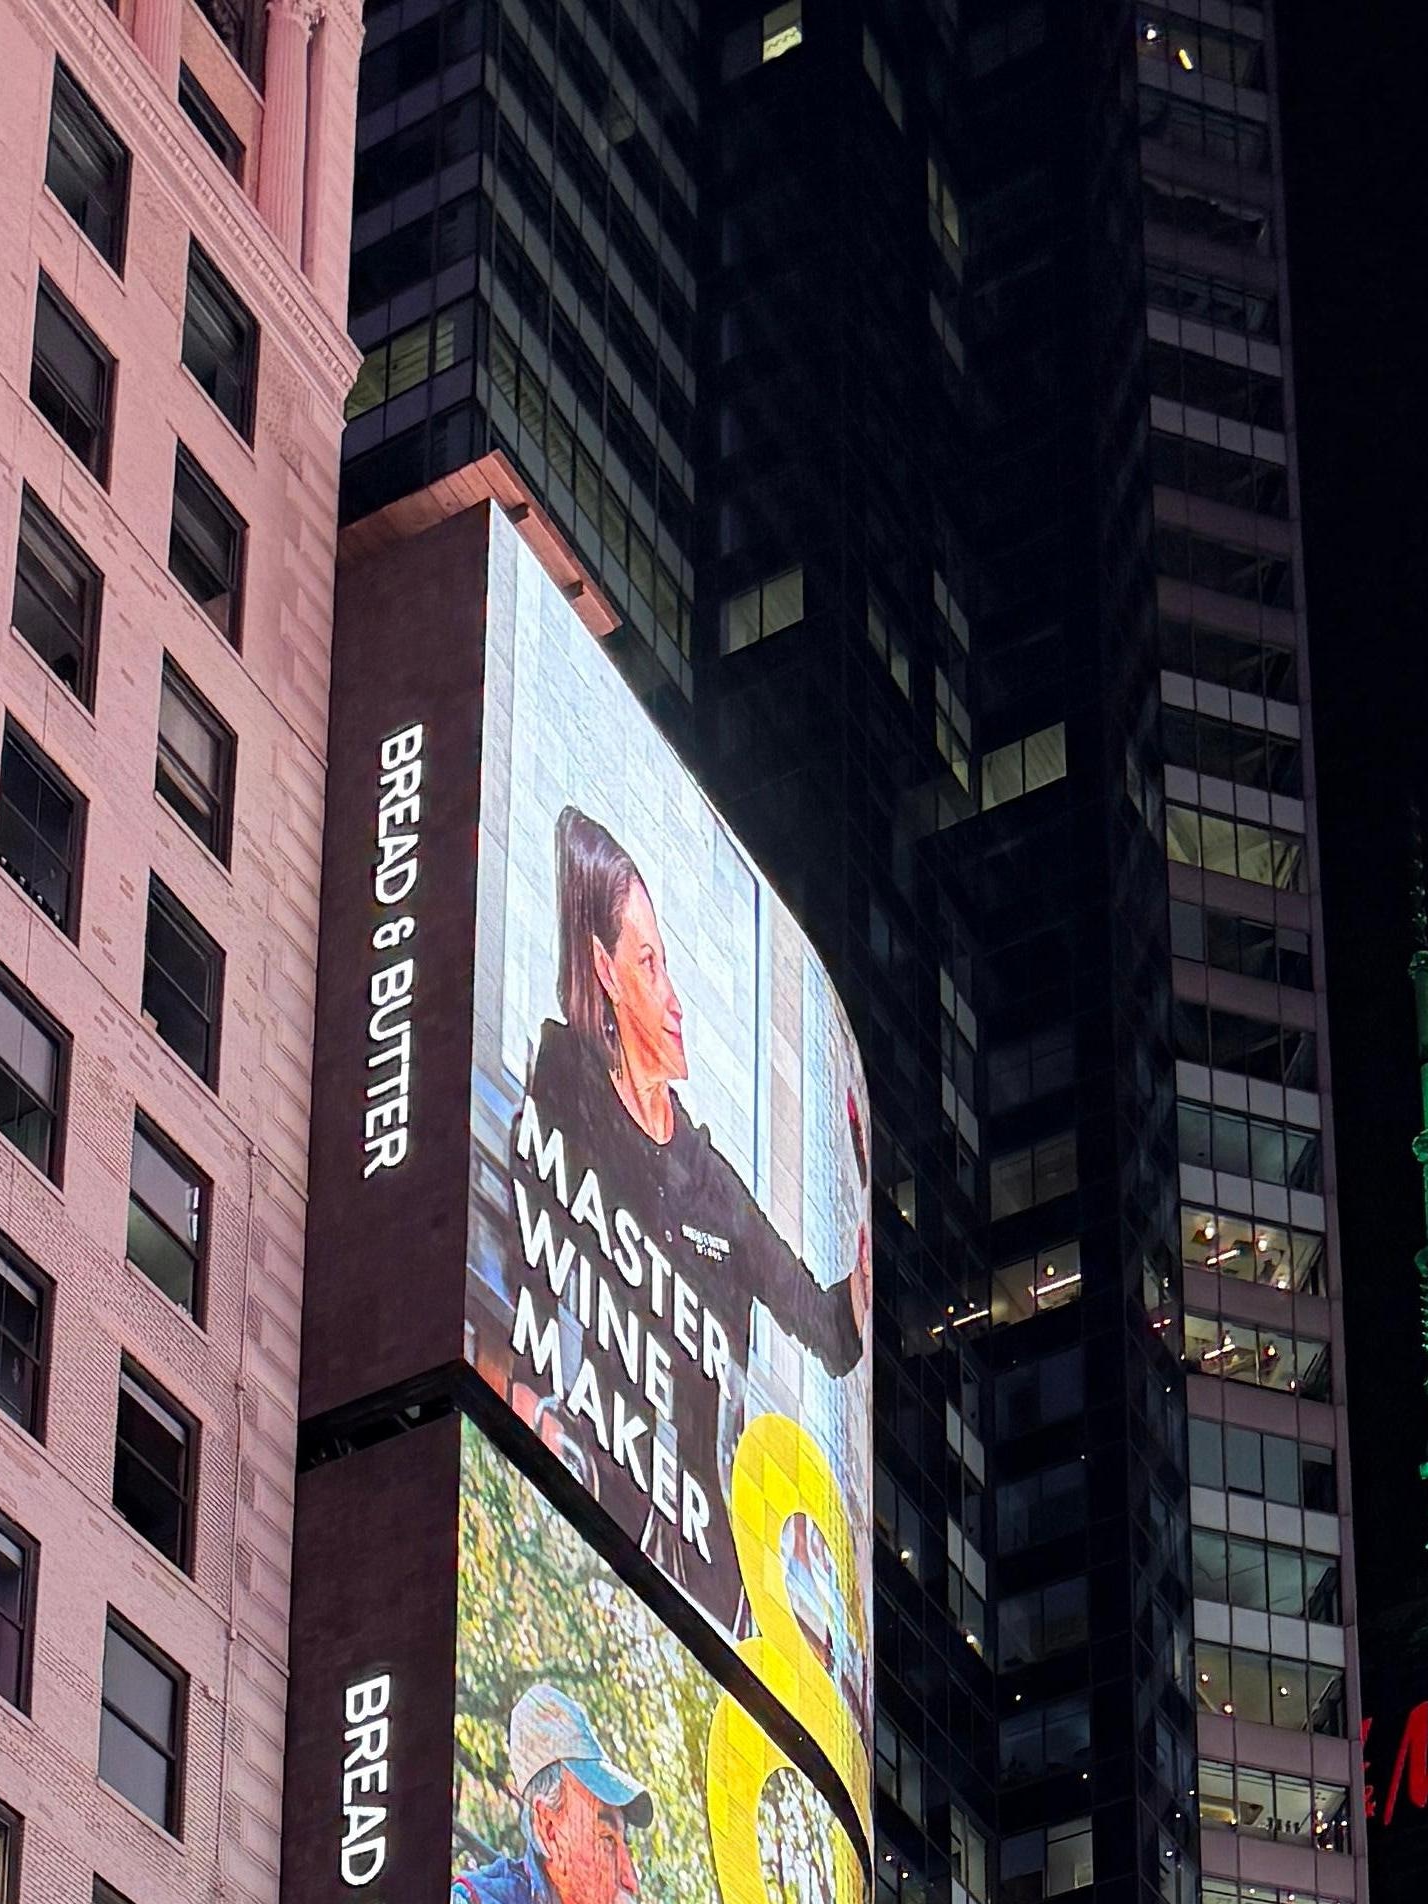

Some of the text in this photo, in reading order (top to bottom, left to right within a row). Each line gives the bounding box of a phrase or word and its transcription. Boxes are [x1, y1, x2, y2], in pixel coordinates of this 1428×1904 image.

[363, 723, 424, 1178] BREAD & BUTTER
[512, 1178, 670, 1427] WINE
[516, 1092, 731, 1401] MASTER
[512, 1286, 712, 1566] MAKER
[339, 1674, 390, 1888] BREAD
